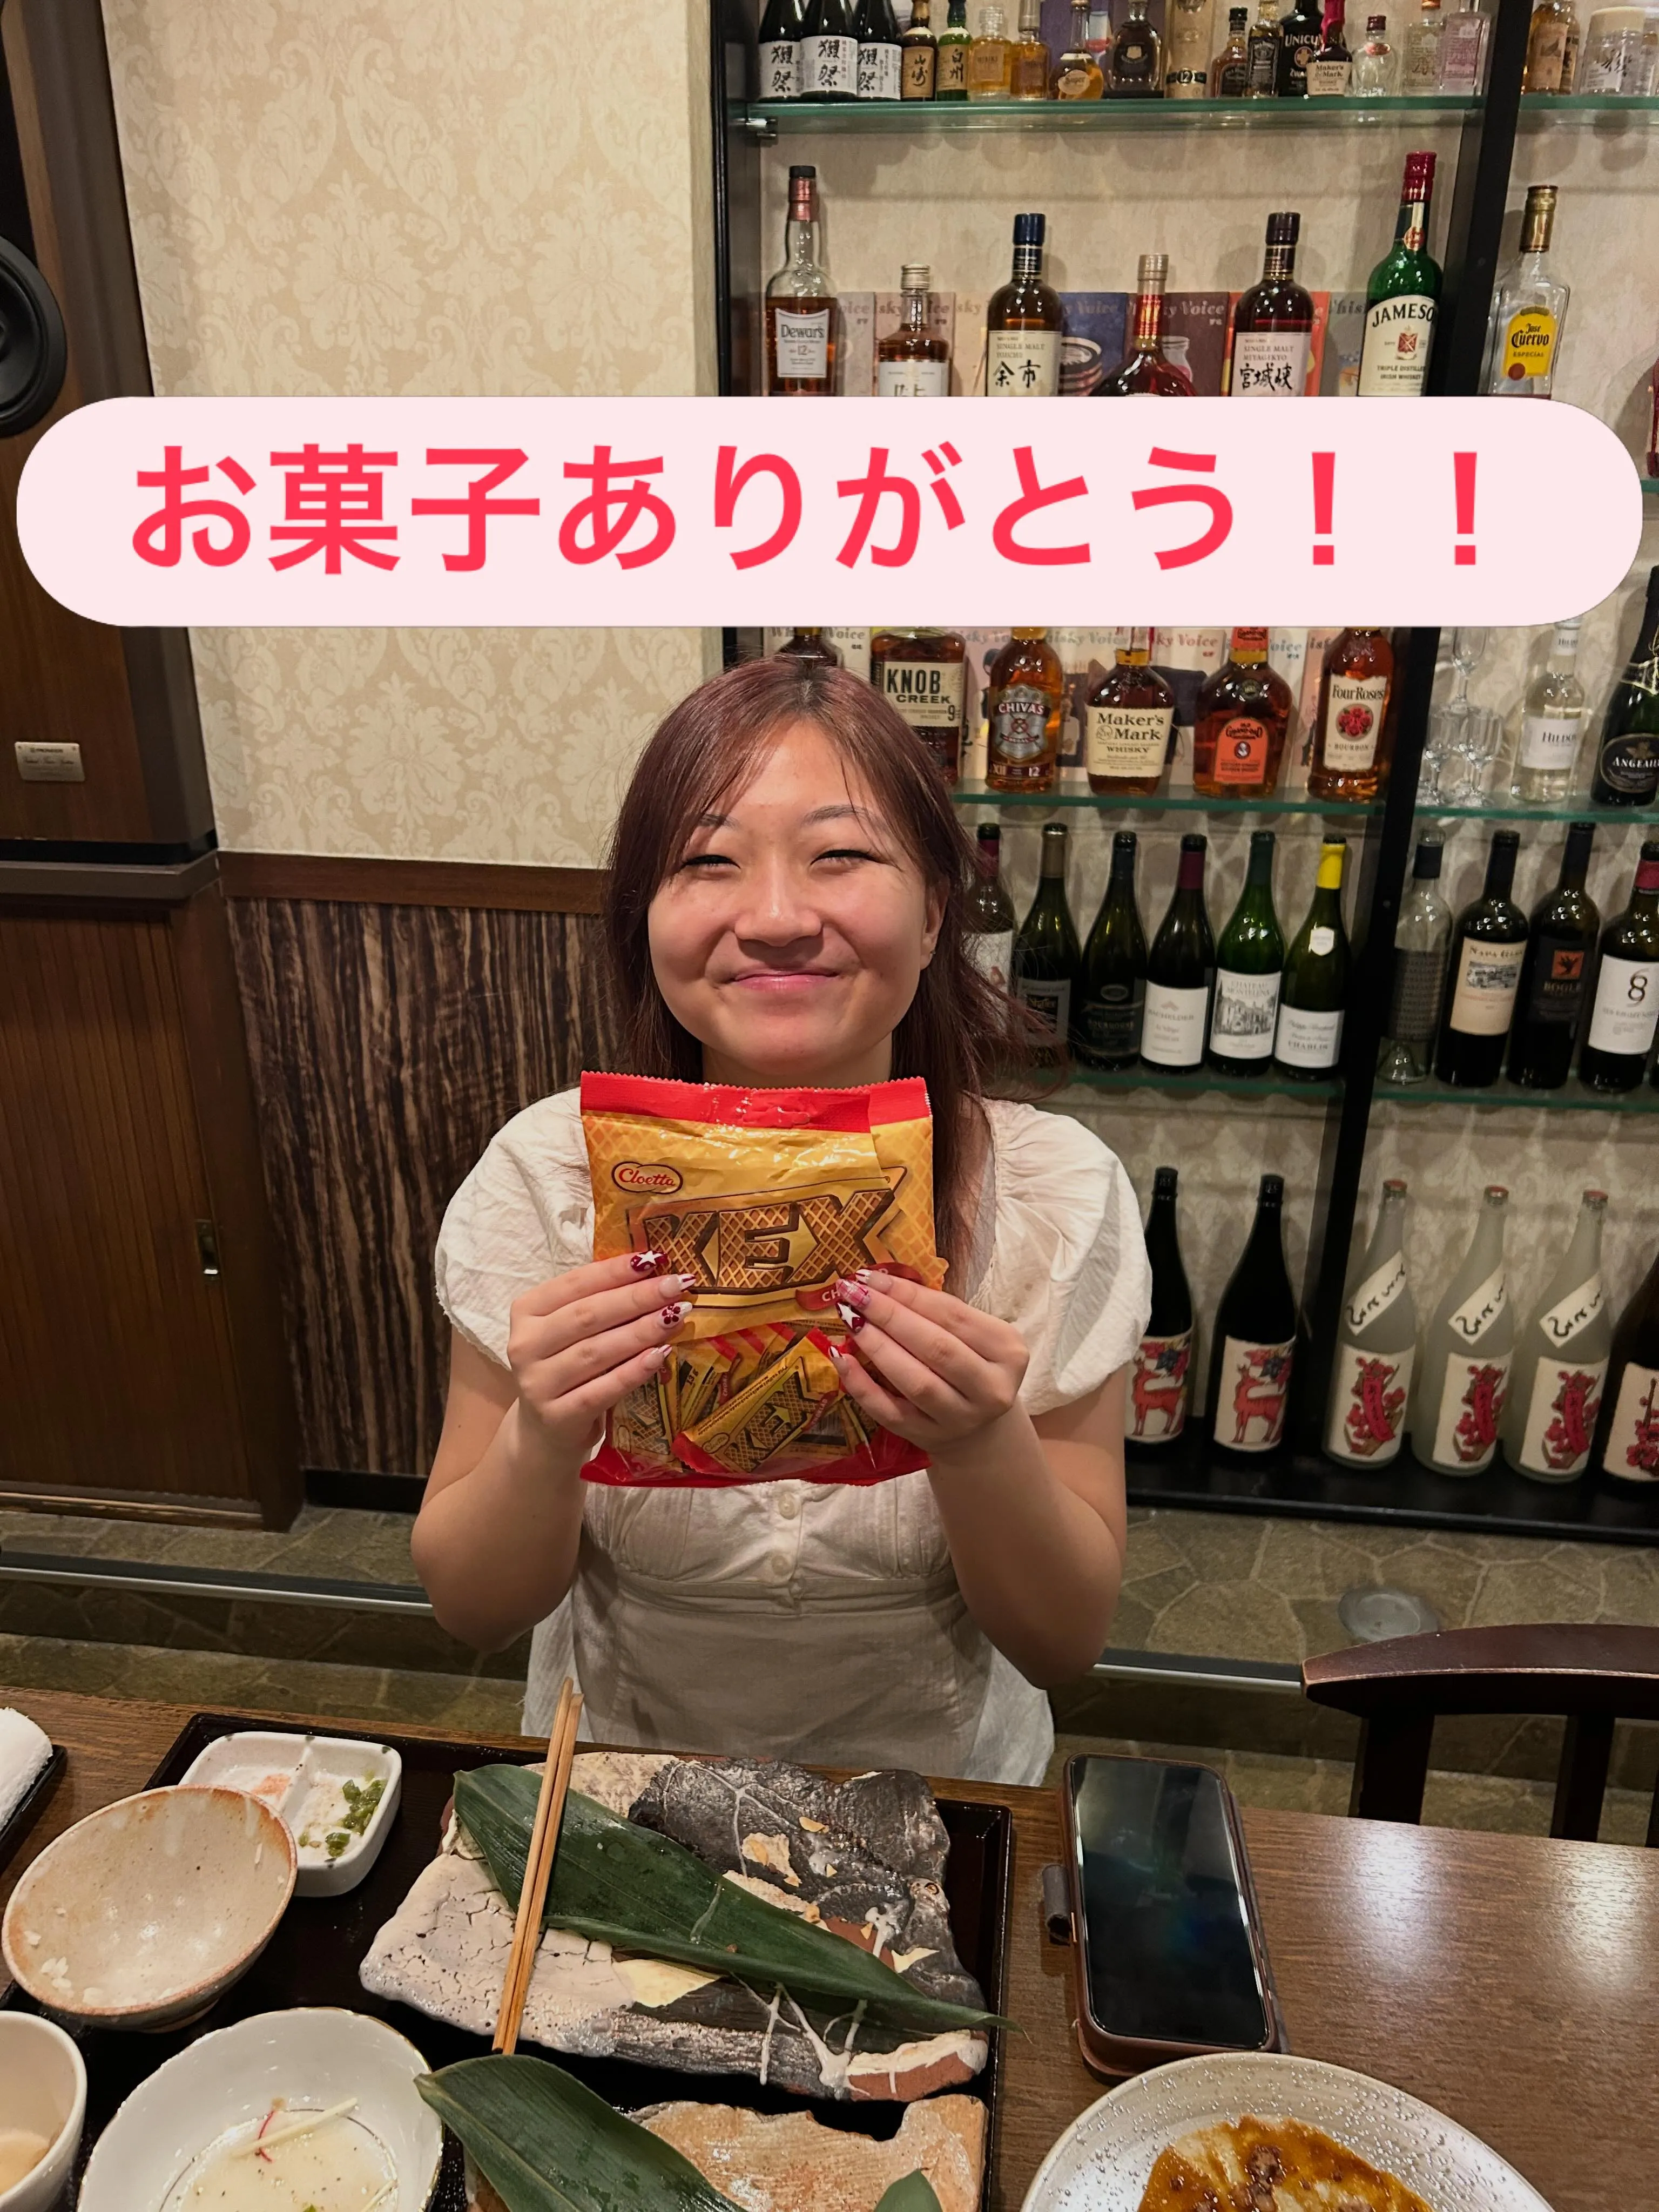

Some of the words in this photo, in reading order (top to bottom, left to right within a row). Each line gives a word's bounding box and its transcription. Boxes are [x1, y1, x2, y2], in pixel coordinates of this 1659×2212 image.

[950, 48, 964, 82] 白州
[1181, 300, 1225, 316] Voice
[780, 323, 825, 339] Dewar's
[1511, 329, 1549, 348] Cuervo
[993, 359, 1042, 389] 余市
[887, 669, 941, 694] KNOB
[896, 694, 951, 704] CREEK
[1332, 684, 1355, 699] Four
[1355, 686, 1385, 700] Roses
[947, 704, 955, 721] 9
[999, 703, 1044, 715] CHIVAS
[1097, 712, 1164, 726] Maker's
[1114, 728, 1162, 741] Mark
[1028, 766, 1041, 777] 12
[618, 1168, 676, 1186] Cloetta
[644, 1188, 896, 1295] KEX
